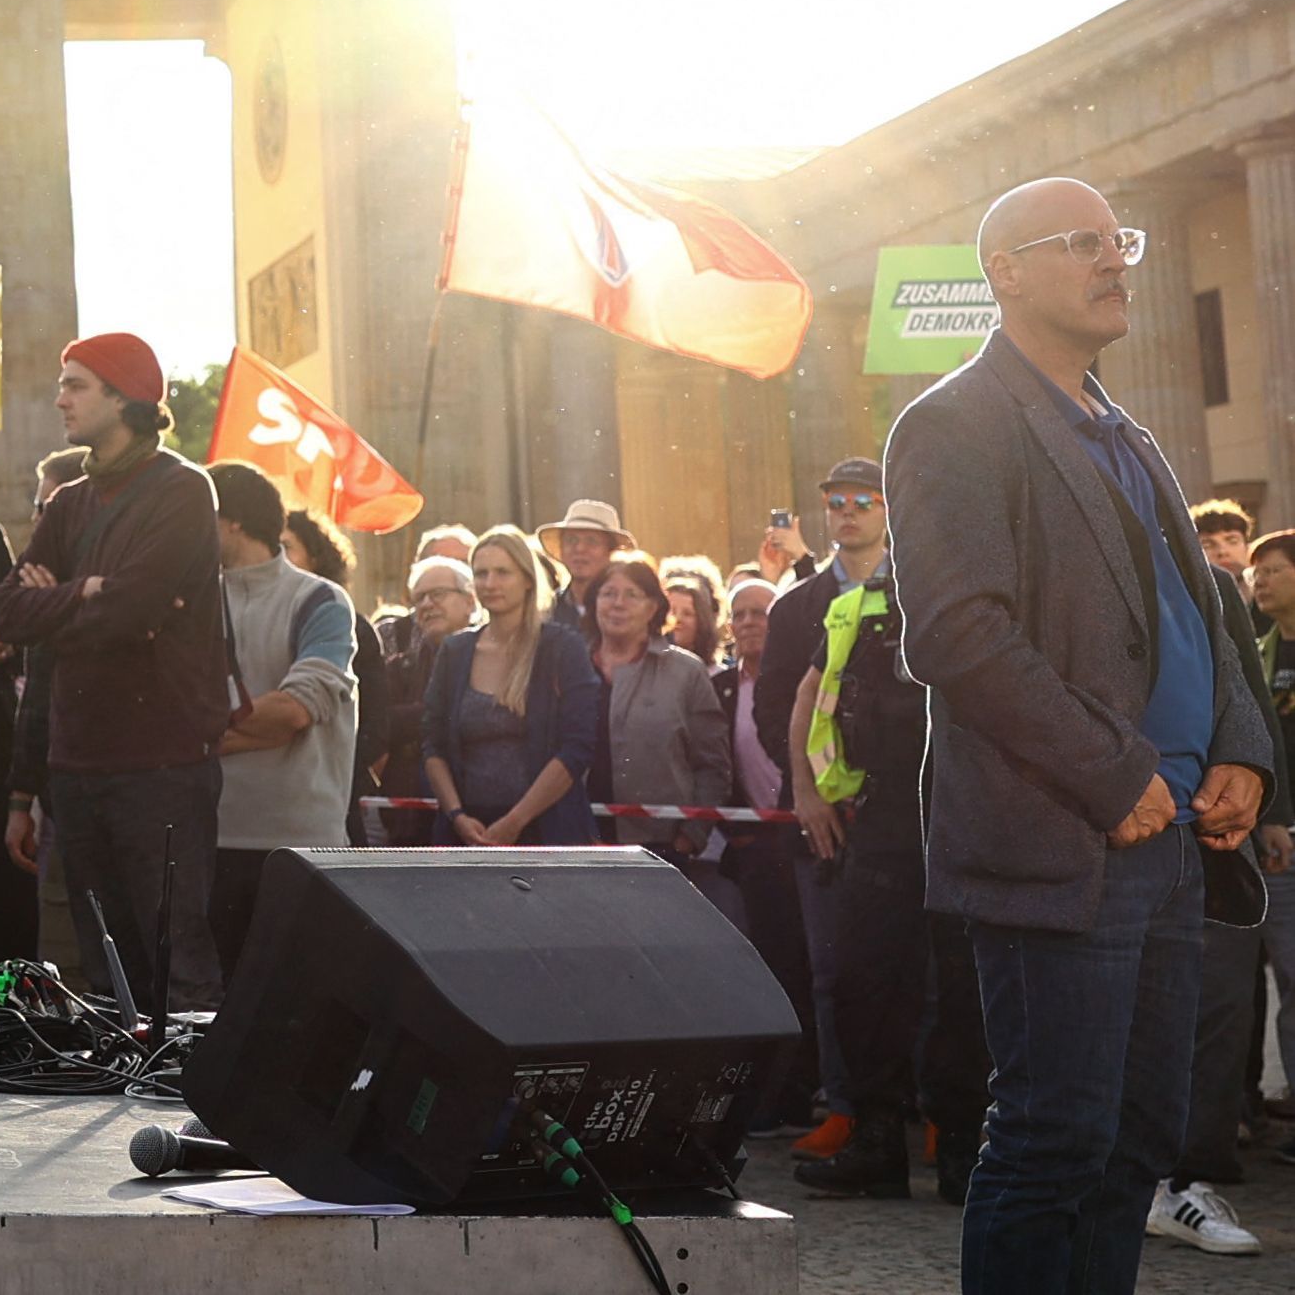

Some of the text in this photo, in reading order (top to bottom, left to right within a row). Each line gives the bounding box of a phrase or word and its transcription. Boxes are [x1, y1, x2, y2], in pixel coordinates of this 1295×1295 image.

[584, 1101, 604, 1129] the
[593, 1089, 625, 1129] box
[606, 1111, 626, 1142] DSP
[624, 1080, 641, 1106] 110
